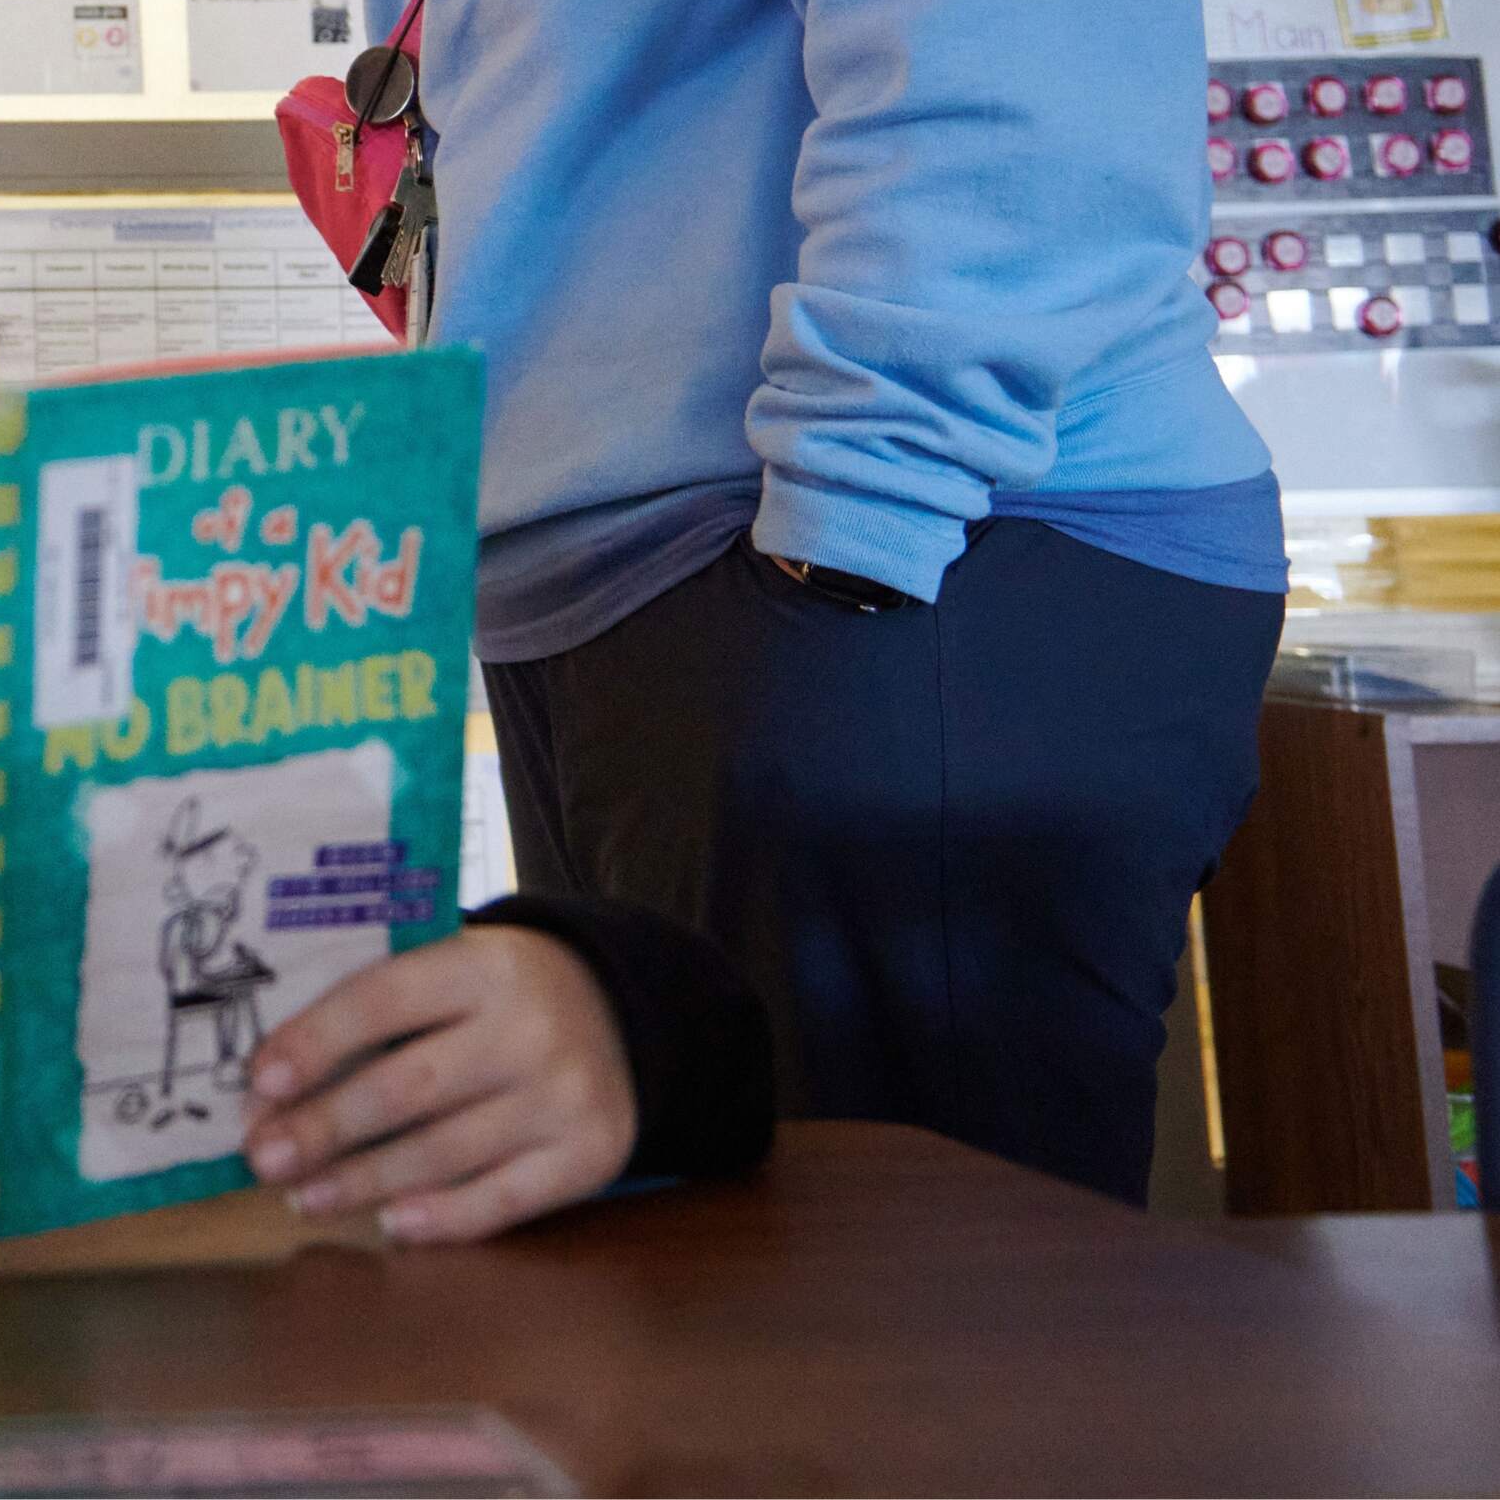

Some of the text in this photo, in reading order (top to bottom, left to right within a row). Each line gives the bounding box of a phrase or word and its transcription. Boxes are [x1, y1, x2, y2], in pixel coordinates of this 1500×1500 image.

[137, 400, 366, 487] DIARY
[192, 485, 300, 553] of a
[304, 518, 425, 632] Kid
[165, 648, 438, 756] BRAINER
